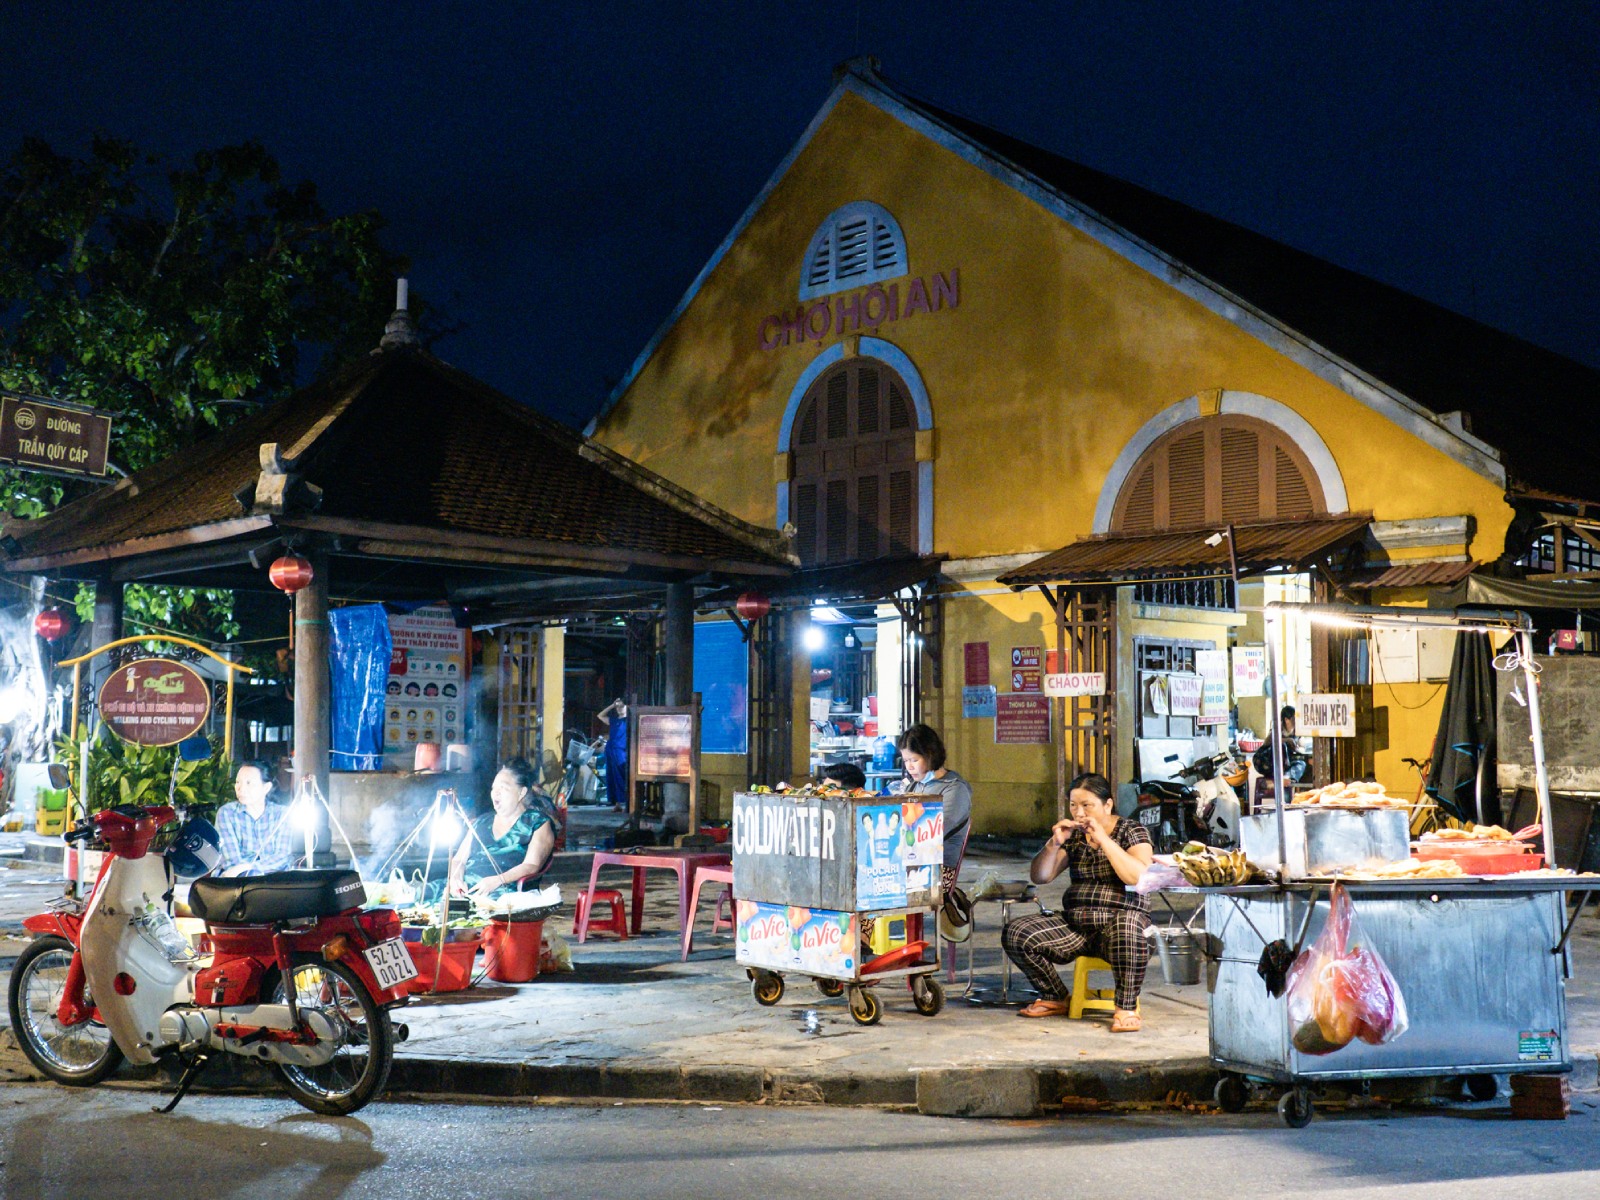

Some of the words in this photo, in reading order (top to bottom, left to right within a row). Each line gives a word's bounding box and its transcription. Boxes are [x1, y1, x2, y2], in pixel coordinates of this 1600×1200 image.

[901, 268, 960, 318] AN
[46, 416, 81, 434] ĐƯỜNG
[69, 446, 89, 463] CÁP
[1048, 673, 1080, 689] CHÁO
[140, 716, 152, 724] AND
[153, 716, 177, 724] CYCLING
[178, 716, 195, 724] TOWN
[1303, 698, 1328, 726] BÁNH
[1330, 698, 1348, 726] XÈO
[867, 864, 899, 878] POCARI
[380, 959, 413, 984] 0024
